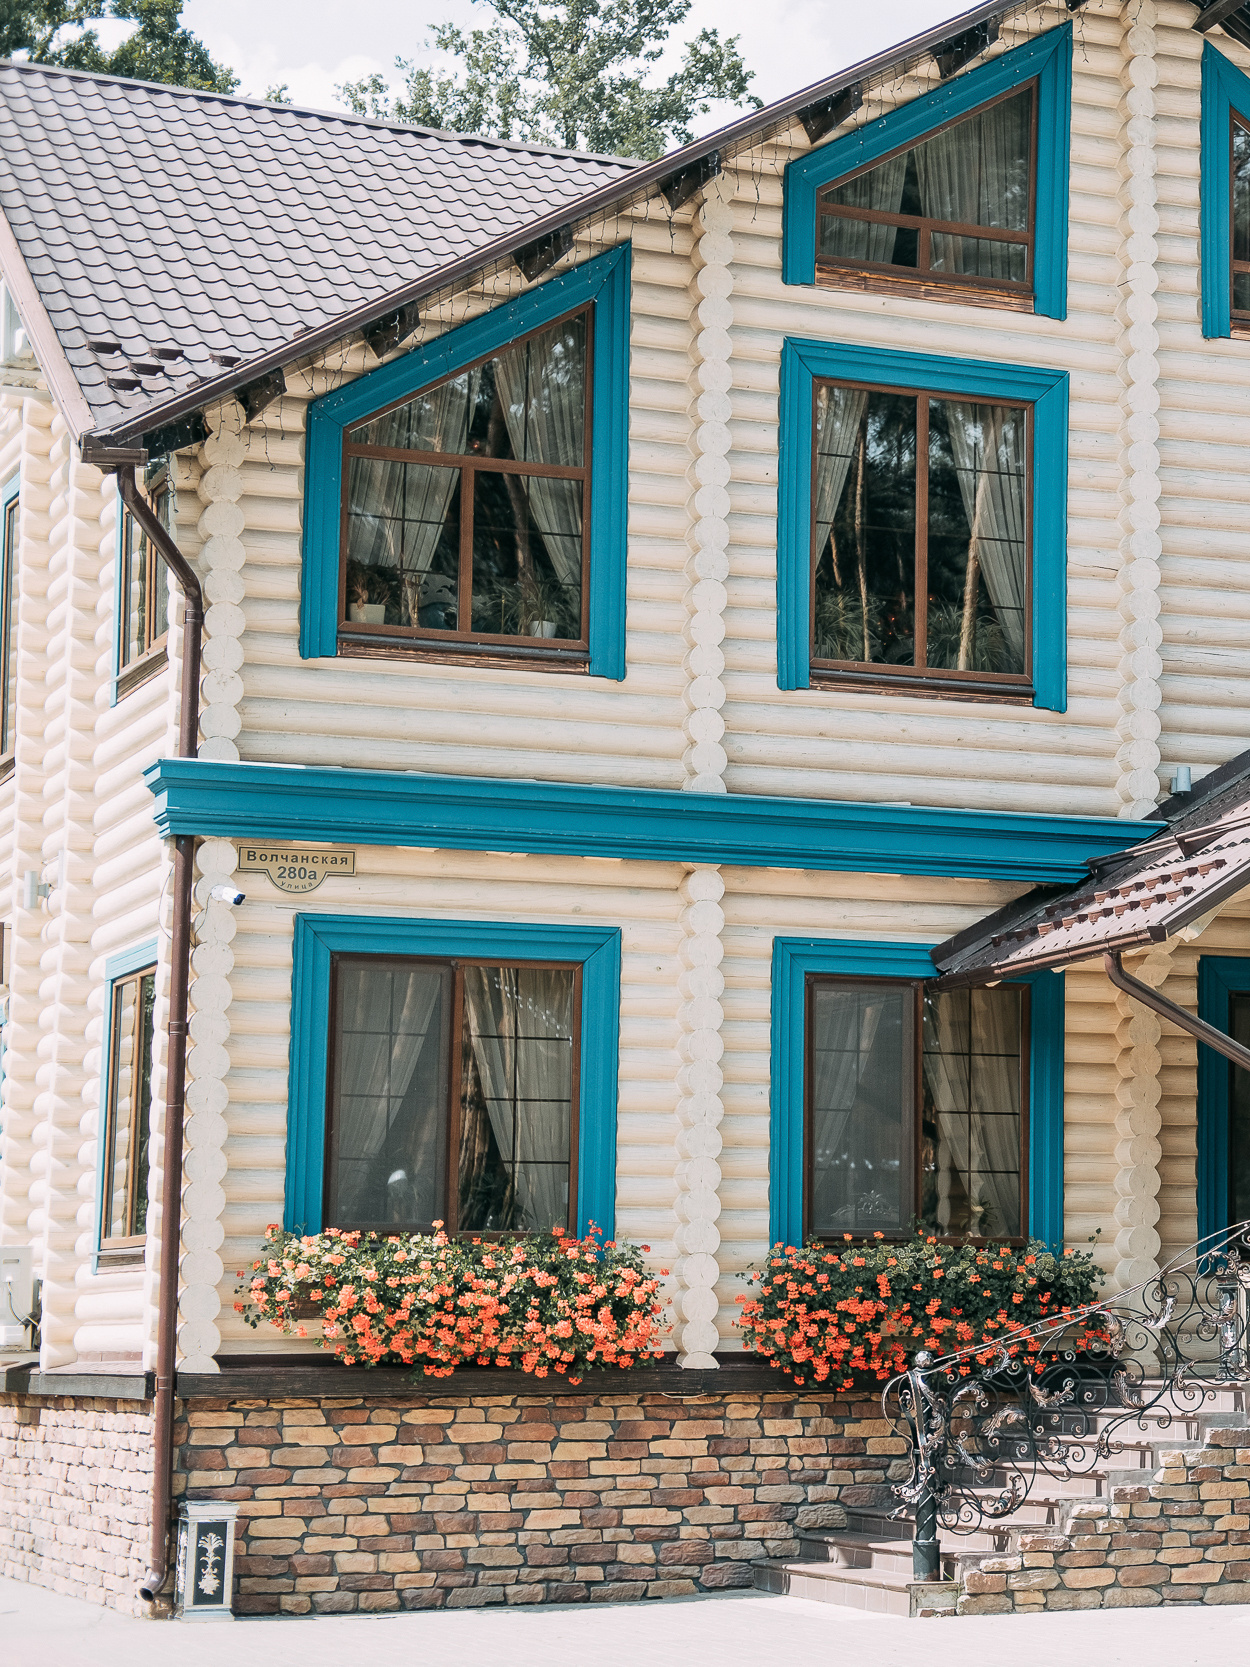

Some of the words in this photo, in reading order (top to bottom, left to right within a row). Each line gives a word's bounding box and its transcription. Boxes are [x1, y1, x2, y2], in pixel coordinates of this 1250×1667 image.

[247, 850, 348, 865] Волчанская
[277, 866, 317, 880] 280а
[280, 881, 313, 890] улица
